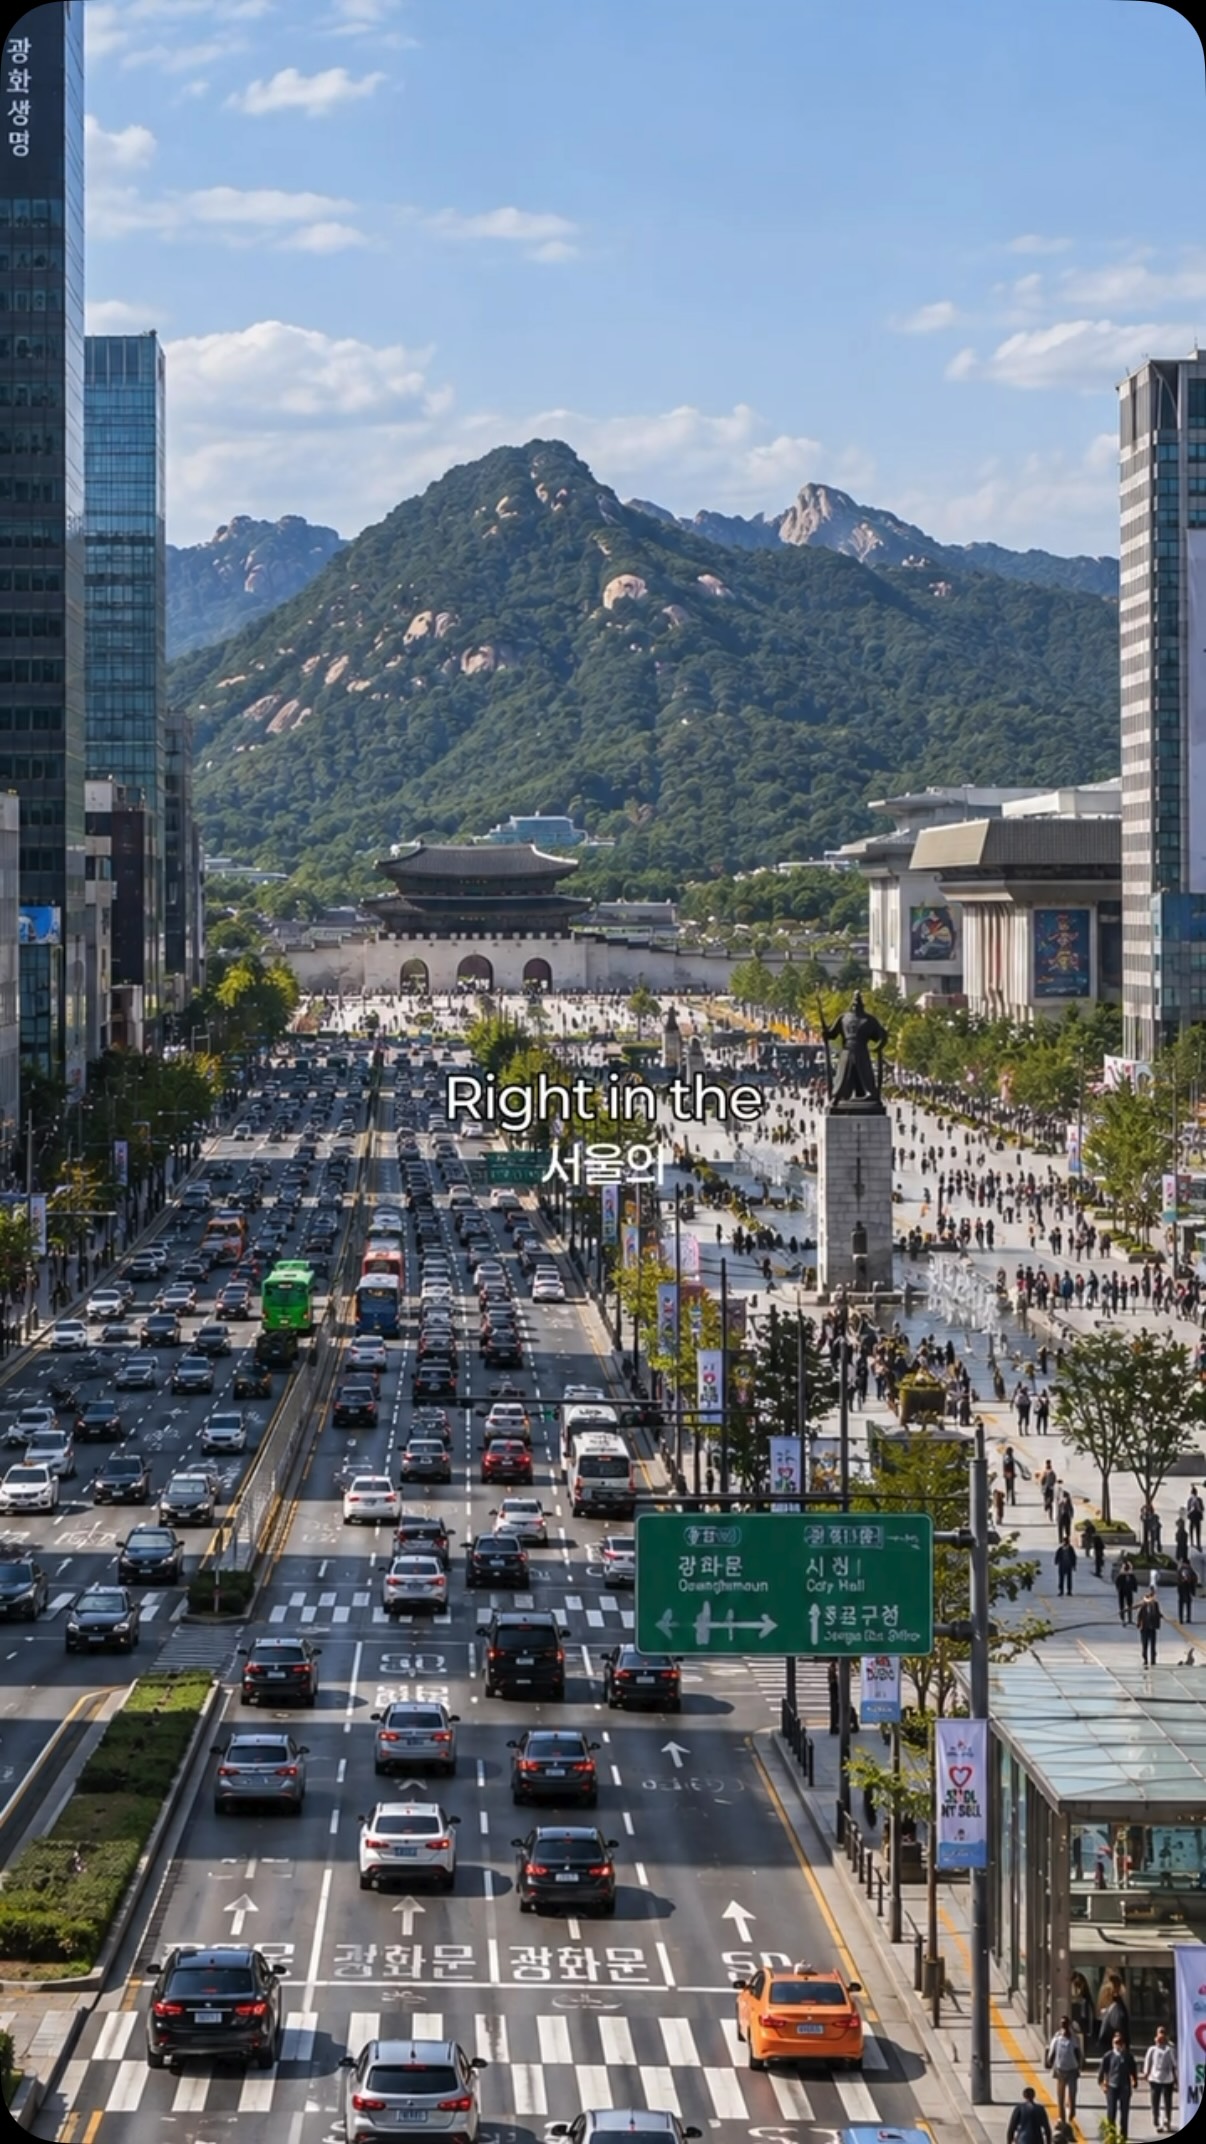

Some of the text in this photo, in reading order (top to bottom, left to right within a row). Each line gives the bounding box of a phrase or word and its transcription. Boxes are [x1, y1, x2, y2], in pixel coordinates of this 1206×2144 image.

[6, 37, 32, 157] 광화생명
[333, 1943, 477, 1980] 광화문
[509, 1945, 650, 1983] 광화문
